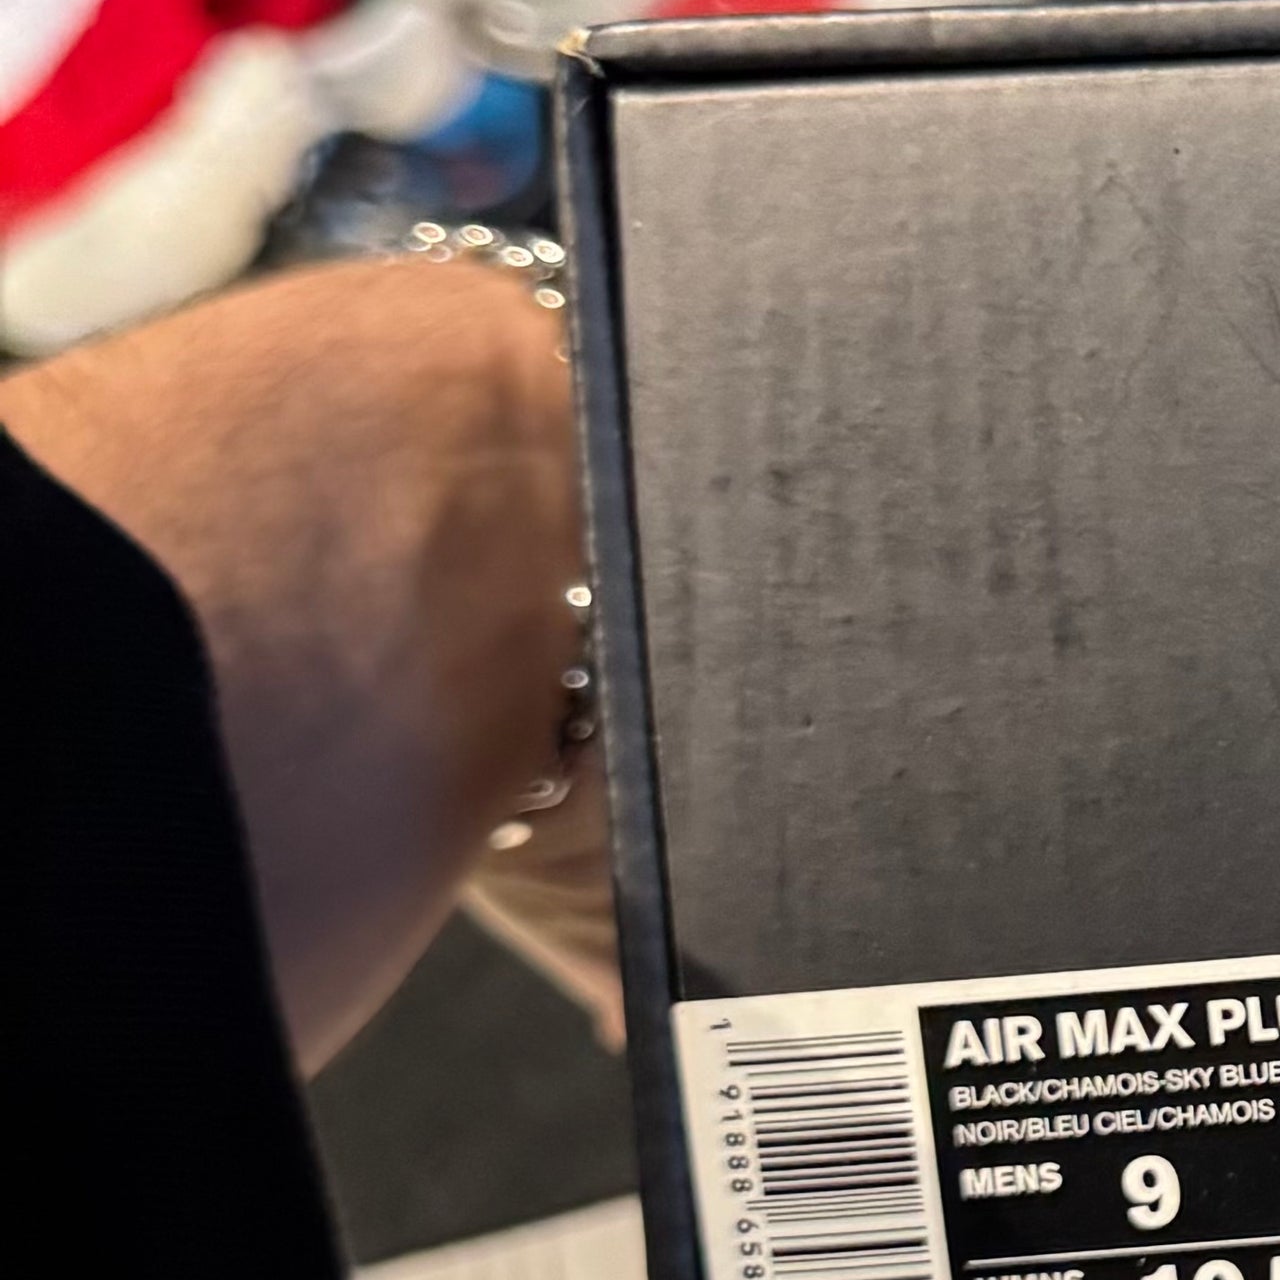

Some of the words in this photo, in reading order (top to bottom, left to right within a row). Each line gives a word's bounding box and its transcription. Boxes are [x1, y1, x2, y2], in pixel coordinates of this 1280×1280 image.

[709, 1018, 732, 1031] 1
[944, 1015, 1046, 1069] AIR
[1056, 1002, 1195, 1058] MAX
[949, 1067, 1214, 1111] BLACK/CHAMOIS-SKY
[952, 1114, 1090, 1147] NOIR/BLEU
[1093, 1098, 1276, 1133] CIEL/CHAMOIS
[959, 1162, 1063, 1200] MENS
[1121, 1154, 1181, 1231] 9
